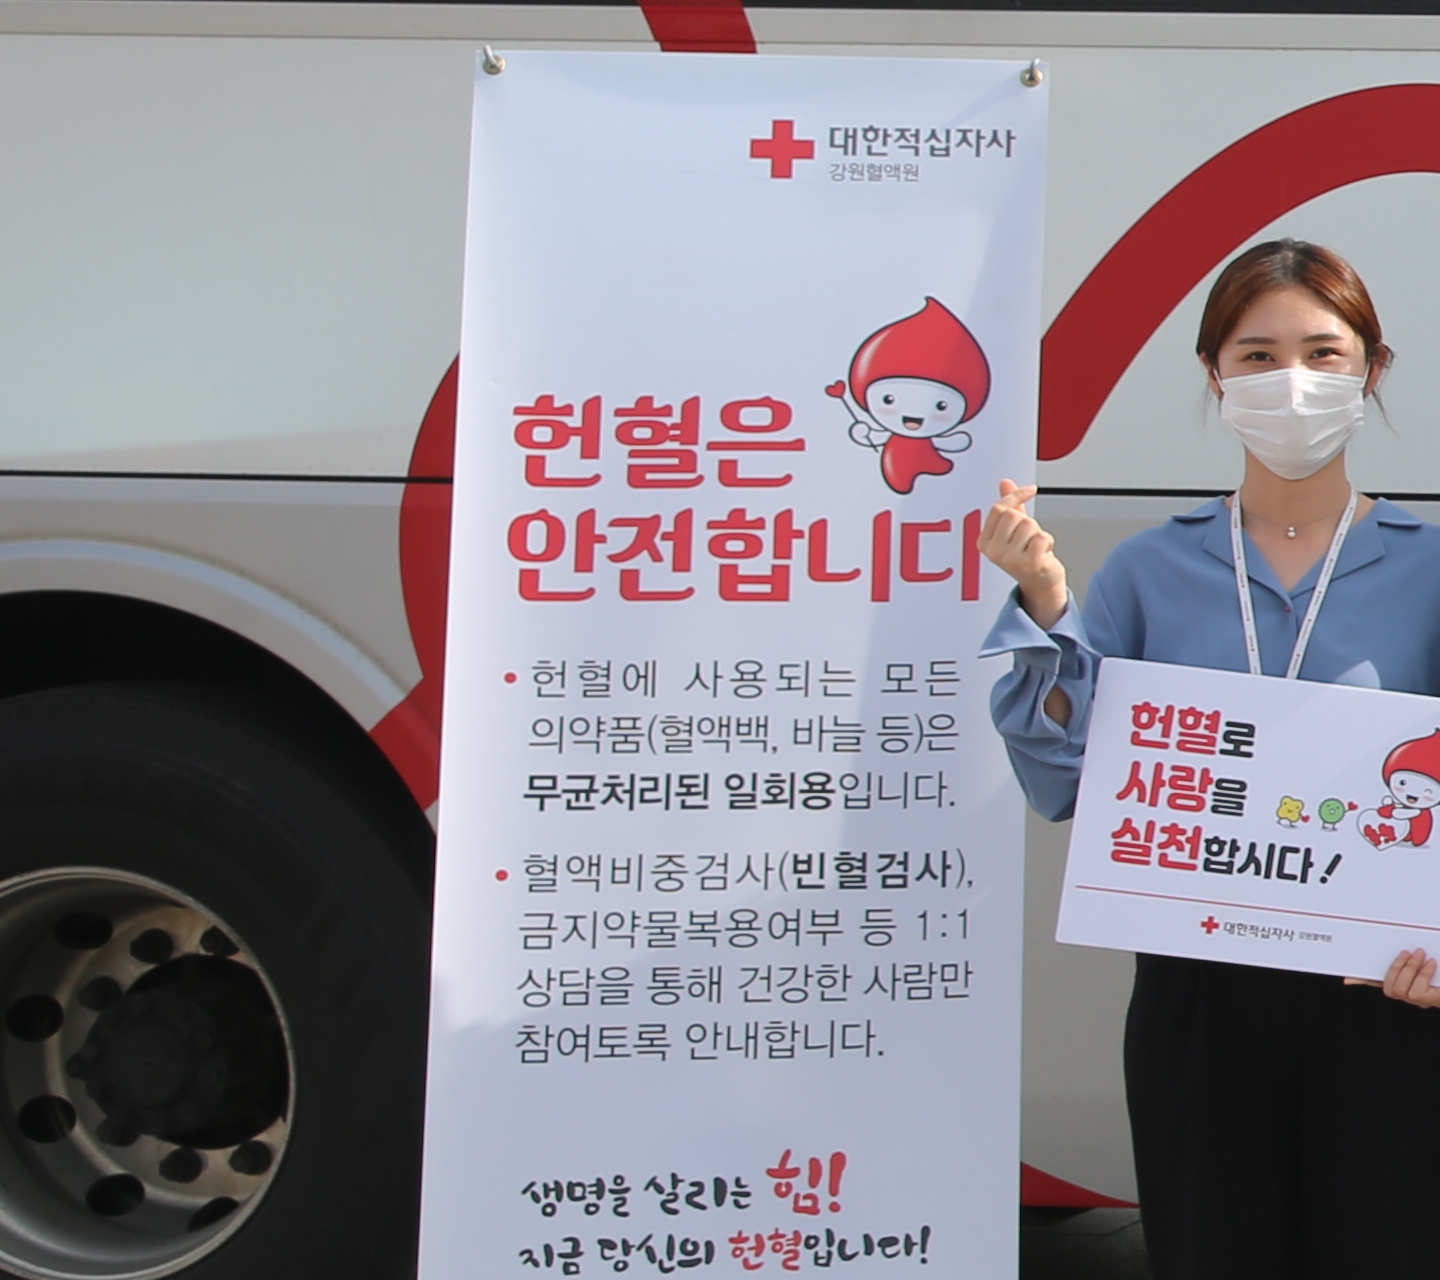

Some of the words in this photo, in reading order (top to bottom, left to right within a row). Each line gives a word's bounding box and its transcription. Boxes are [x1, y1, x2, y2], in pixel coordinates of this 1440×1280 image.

[829, 124, 1017, 158] 대한적십자사
[829, 162, 920, 183] 강원혈액원
[513, 394, 806, 489] 헌혈은
[507, 507, 982, 602] 안전합니다
[531, 659, 659, 698] 헌혈에
[684, 659, 857, 698] 사용되는
[880, 658, 961, 697] 모든
[527, 714, 778, 756] 의약품(혈액백,
[792, 715, 864, 753] 바늘
[876, 713, 960, 754] 등)은
[1131, 701, 1257, 759] 헌혈로
[523, 773, 711, 812] 무균처리된
[724, 771, 956, 810] 일회용입니다.
[1116, 760, 1248, 817] 사랑을
[523, 848, 974, 894] 혈액비중검사(빈혈검사),
[518, 908, 844, 950] 금지약물복용여부
[859, 909, 897, 947] 등
[916, 907, 972, 941] 1:1
[1223, 921, 1295, 942] 대한적십자사
[516, 965, 634, 1007] 상담을
[646, 963, 723, 1005] 통해
[737, 961, 852, 1003] 건강한
[864, 959, 973, 1001] 사람만
[515, 1022, 671, 1064] 참여토록
[685, 1019, 884, 1061] 안내합니다.
[521, 1174, 631, 1218] 생명을
[644, 1172, 752, 1216] 살리는
[766, 1149, 847, 1216] 힘!
[519, 1236, 584, 1276] 지금
[597, 1233, 715, 1273] 당신의
[728, 1225, 931, 1271] 헌혈입니다!
